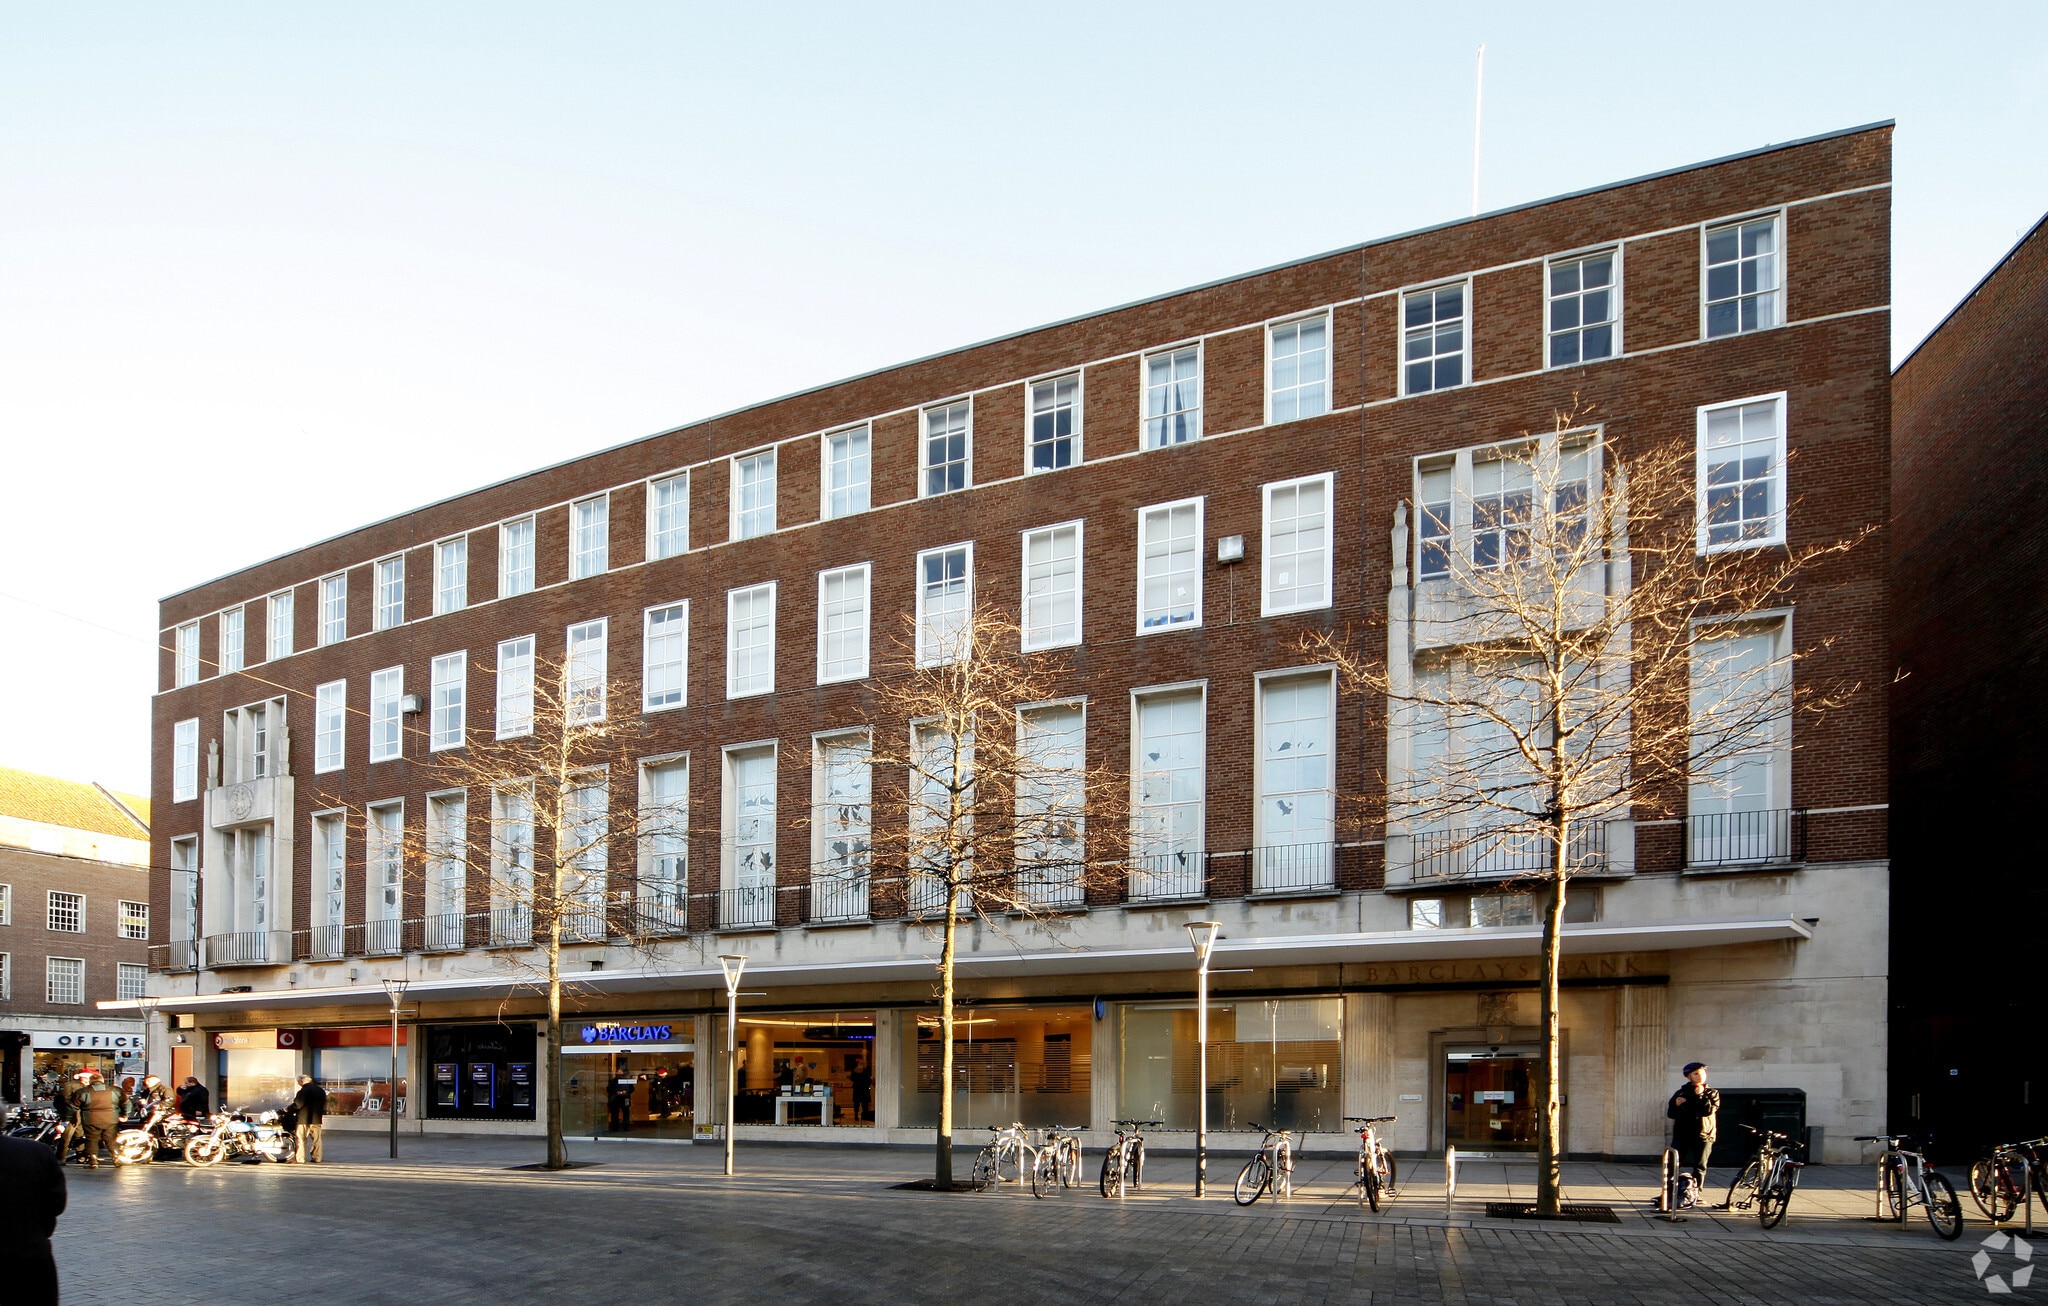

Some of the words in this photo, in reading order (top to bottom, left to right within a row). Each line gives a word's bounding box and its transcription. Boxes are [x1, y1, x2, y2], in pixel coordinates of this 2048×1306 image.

[1367, 961, 1530, 982] BARCLAYS
[1557, 957, 1642, 977] BANK
[598, 1025, 672, 1041] BARCLAYS
[58, 1035, 140, 1048] OFFICE
